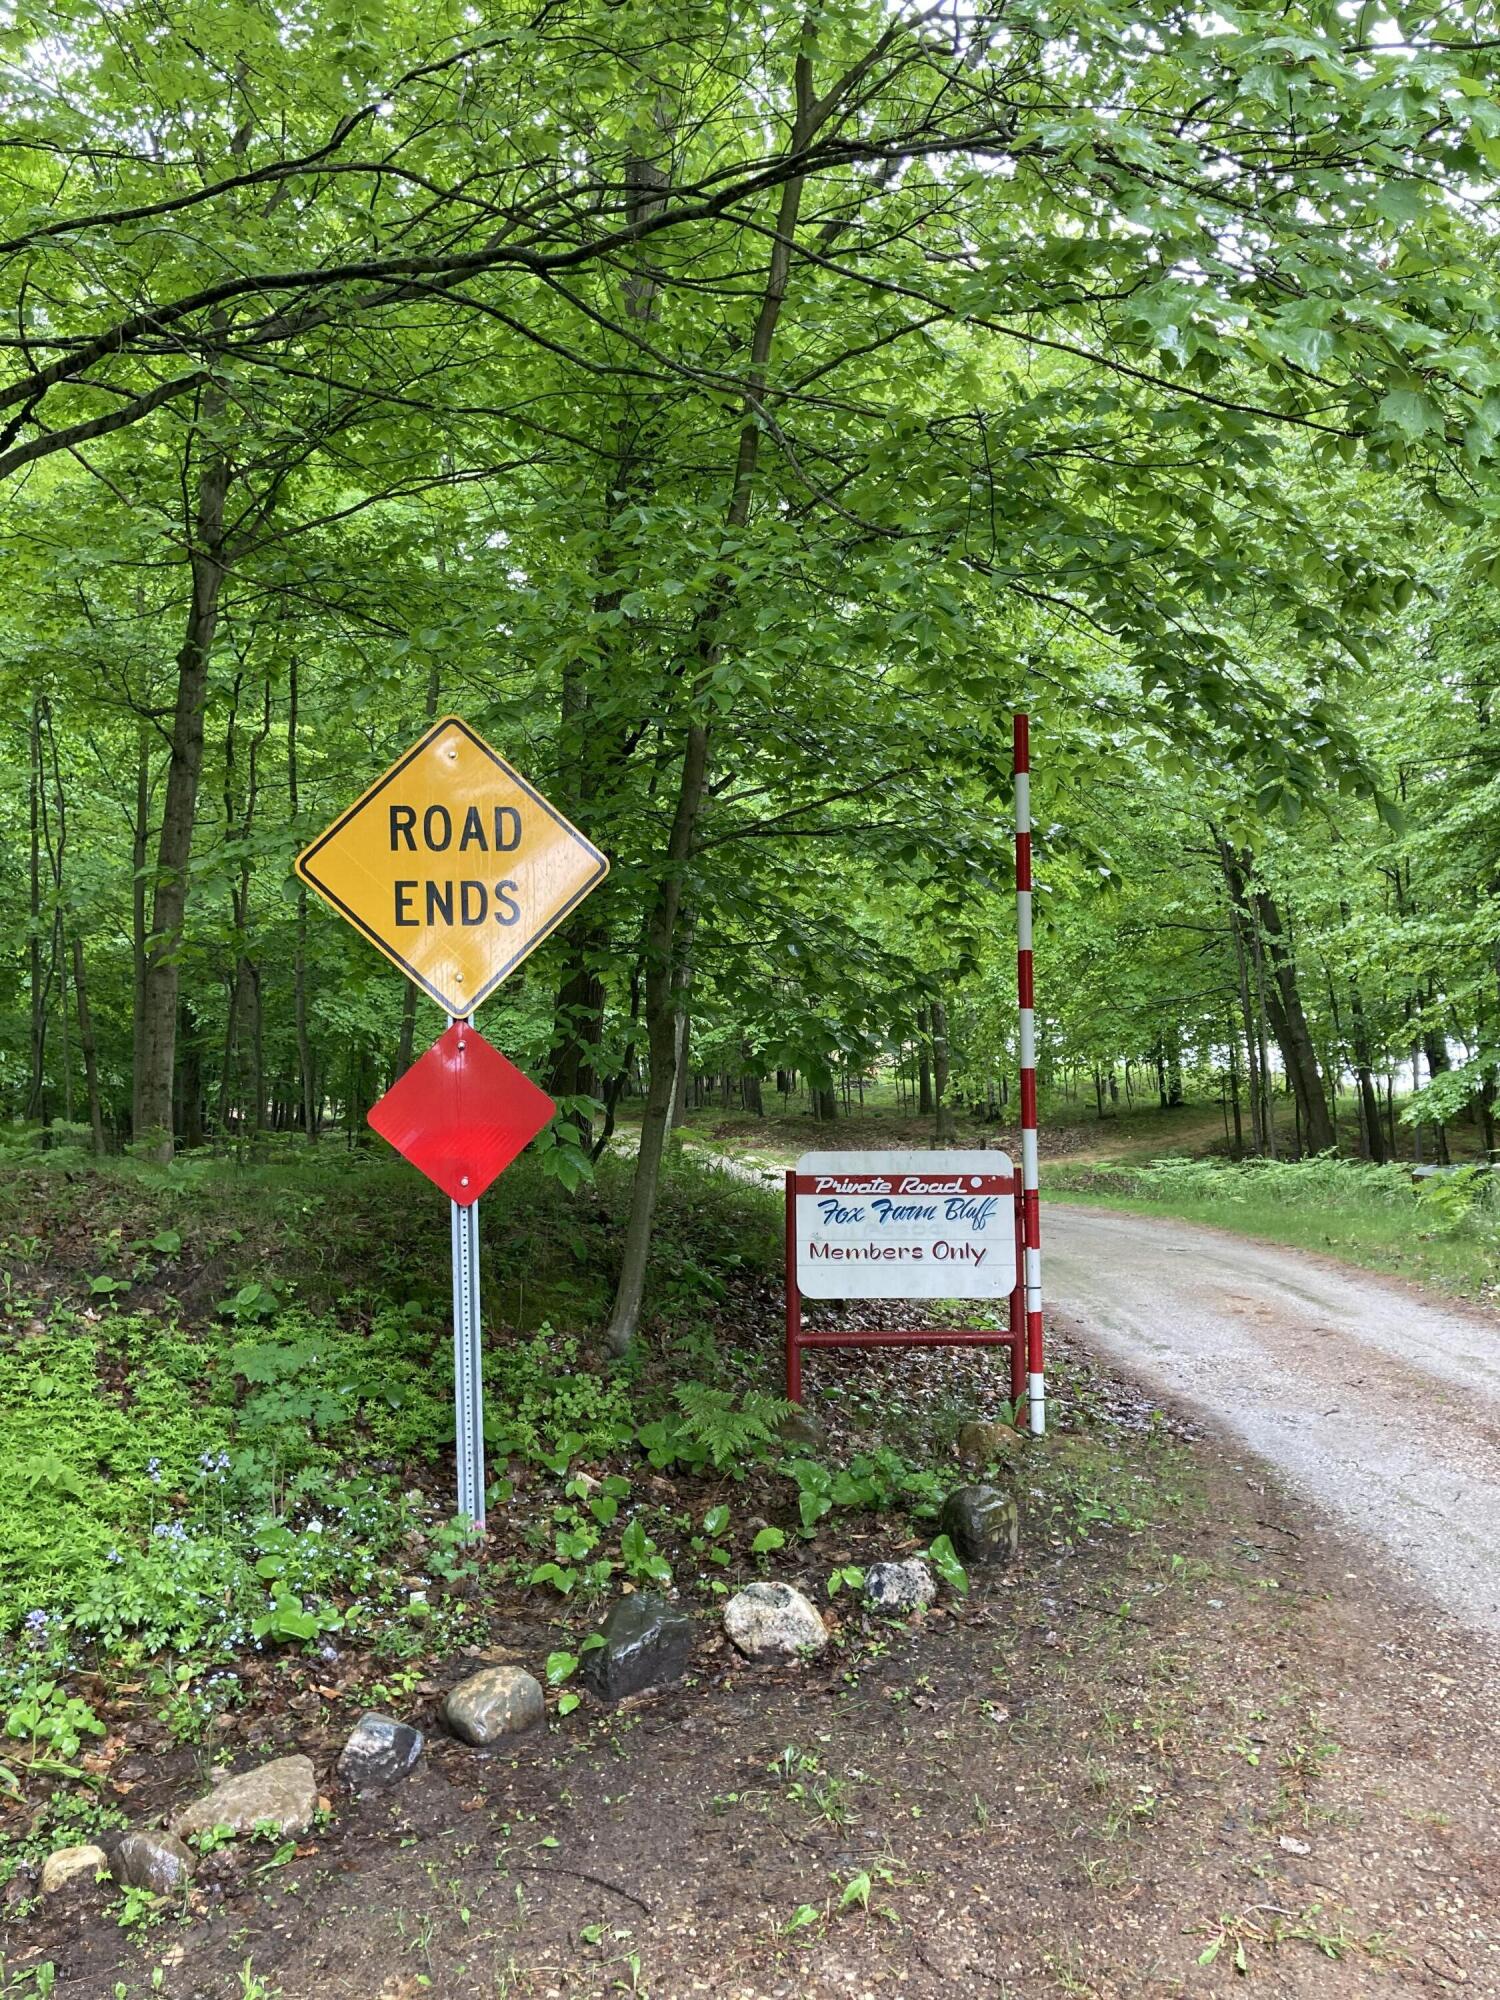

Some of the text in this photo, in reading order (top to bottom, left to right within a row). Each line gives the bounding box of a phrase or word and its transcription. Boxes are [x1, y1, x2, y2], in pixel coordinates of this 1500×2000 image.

[389, 805, 522, 852] ROAD
[394, 879, 521, 926] ENDS
[815, 1177, 967, 1193] Private Road
[817, 1199, 865, 1225] Fox
[871, 1199, 938, 1225] Farm
[944, 1197, 998, 1231] Bluff
[809, 1240, 986, 1267] Members Only
